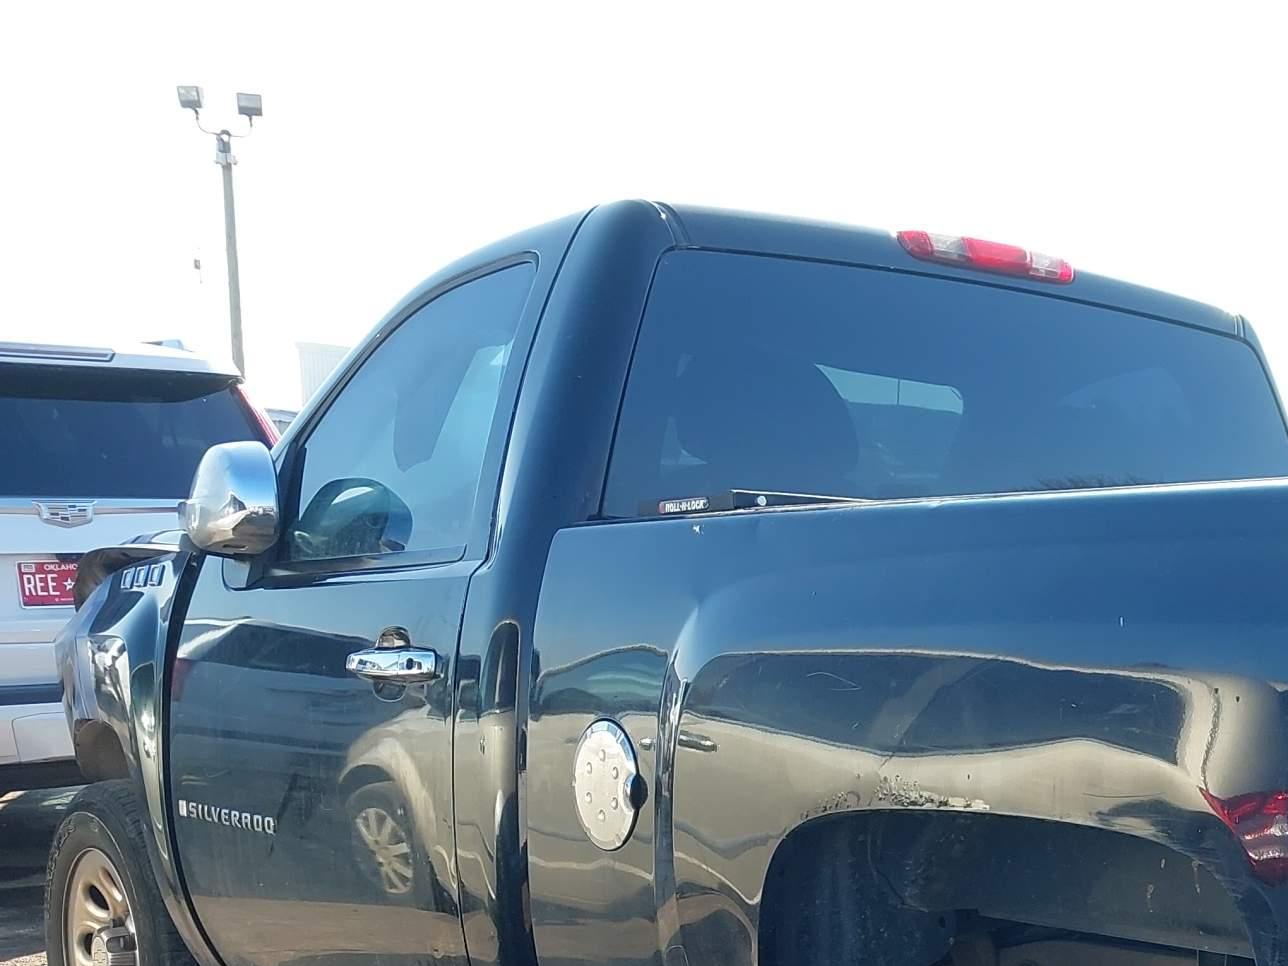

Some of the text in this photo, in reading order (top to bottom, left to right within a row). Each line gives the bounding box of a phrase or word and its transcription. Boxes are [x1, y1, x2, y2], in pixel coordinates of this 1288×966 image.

[43, 563, 78, 571] OKLAHO
[22, 573, 60, 596] REE
[188, 801, 276, 835] SILVERADO
